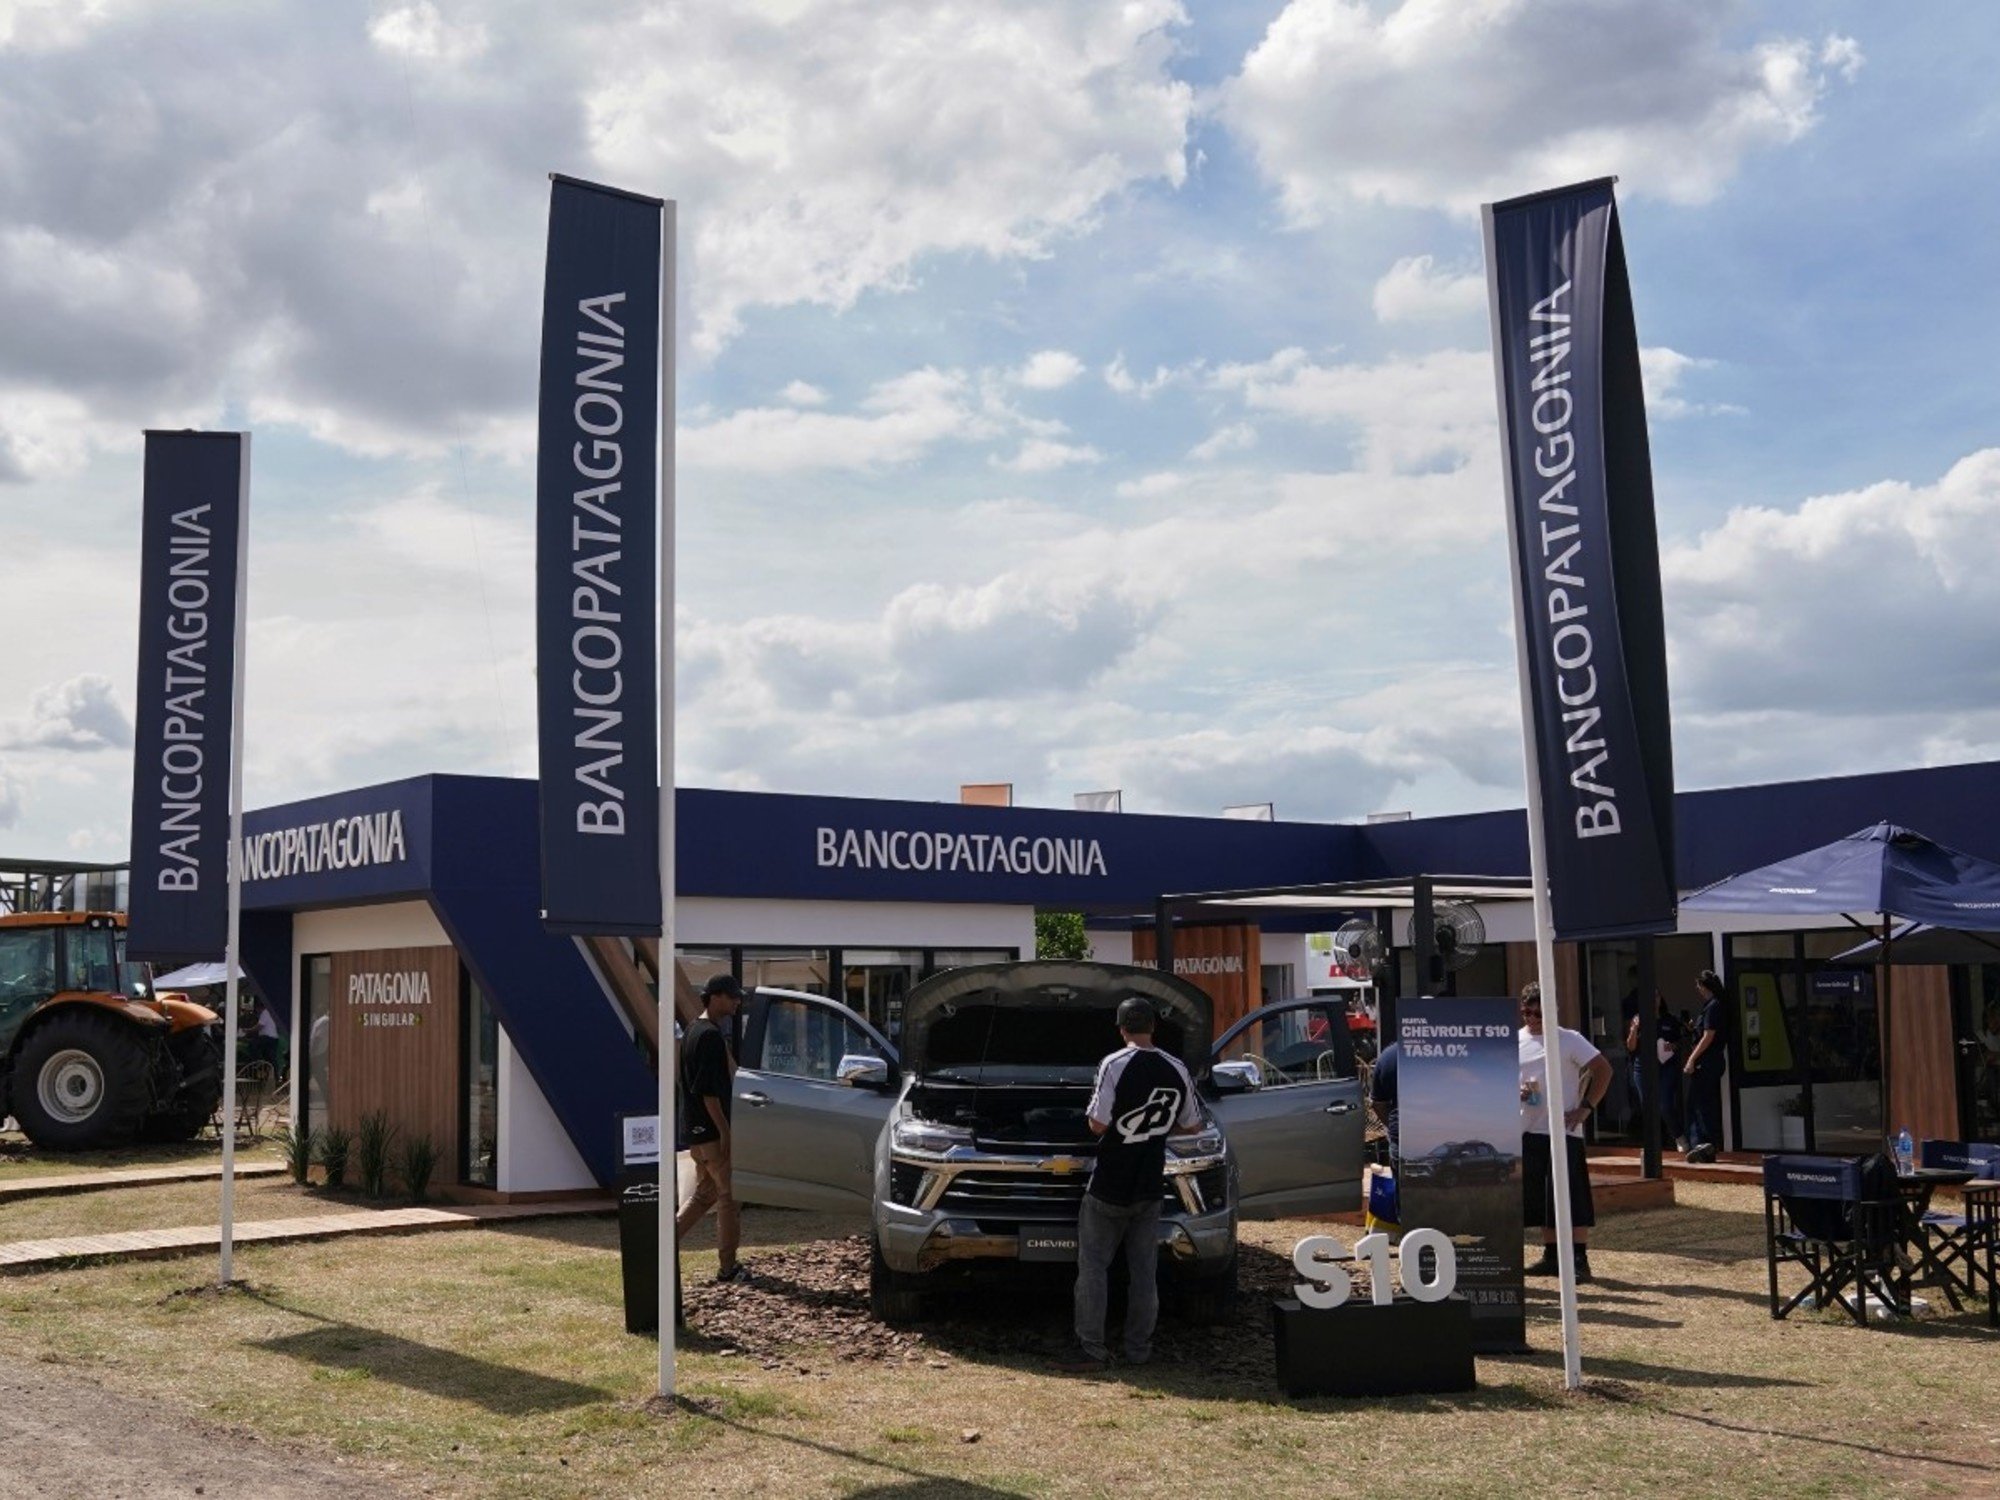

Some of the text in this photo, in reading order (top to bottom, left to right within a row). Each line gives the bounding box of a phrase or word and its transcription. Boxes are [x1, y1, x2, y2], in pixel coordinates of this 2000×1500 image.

[572, 291, 627, 836] BANCOPATAGONIA
[1530, 279, 1622, 839] BANCOPATAGONIA
[158, 502, 212, 891] BANCOPATAGONIA
[227, 809, 406, 883] NCOPATAGONIA
[817, 827, 1107, 876] BANCOPATAGONIA
[348, 971, 432, 1005] PATAGONIA
[363, 1012, 415, 1027] SINGULAR
[1401, 1025, 1510, 1038] CHEVROLET S10
[1403, 1044, 1468, 1057] TASA 0%
[1026, 1239, 1078, 1248] CHEVRO
[1293, 1227, 1457, 1309] S10
